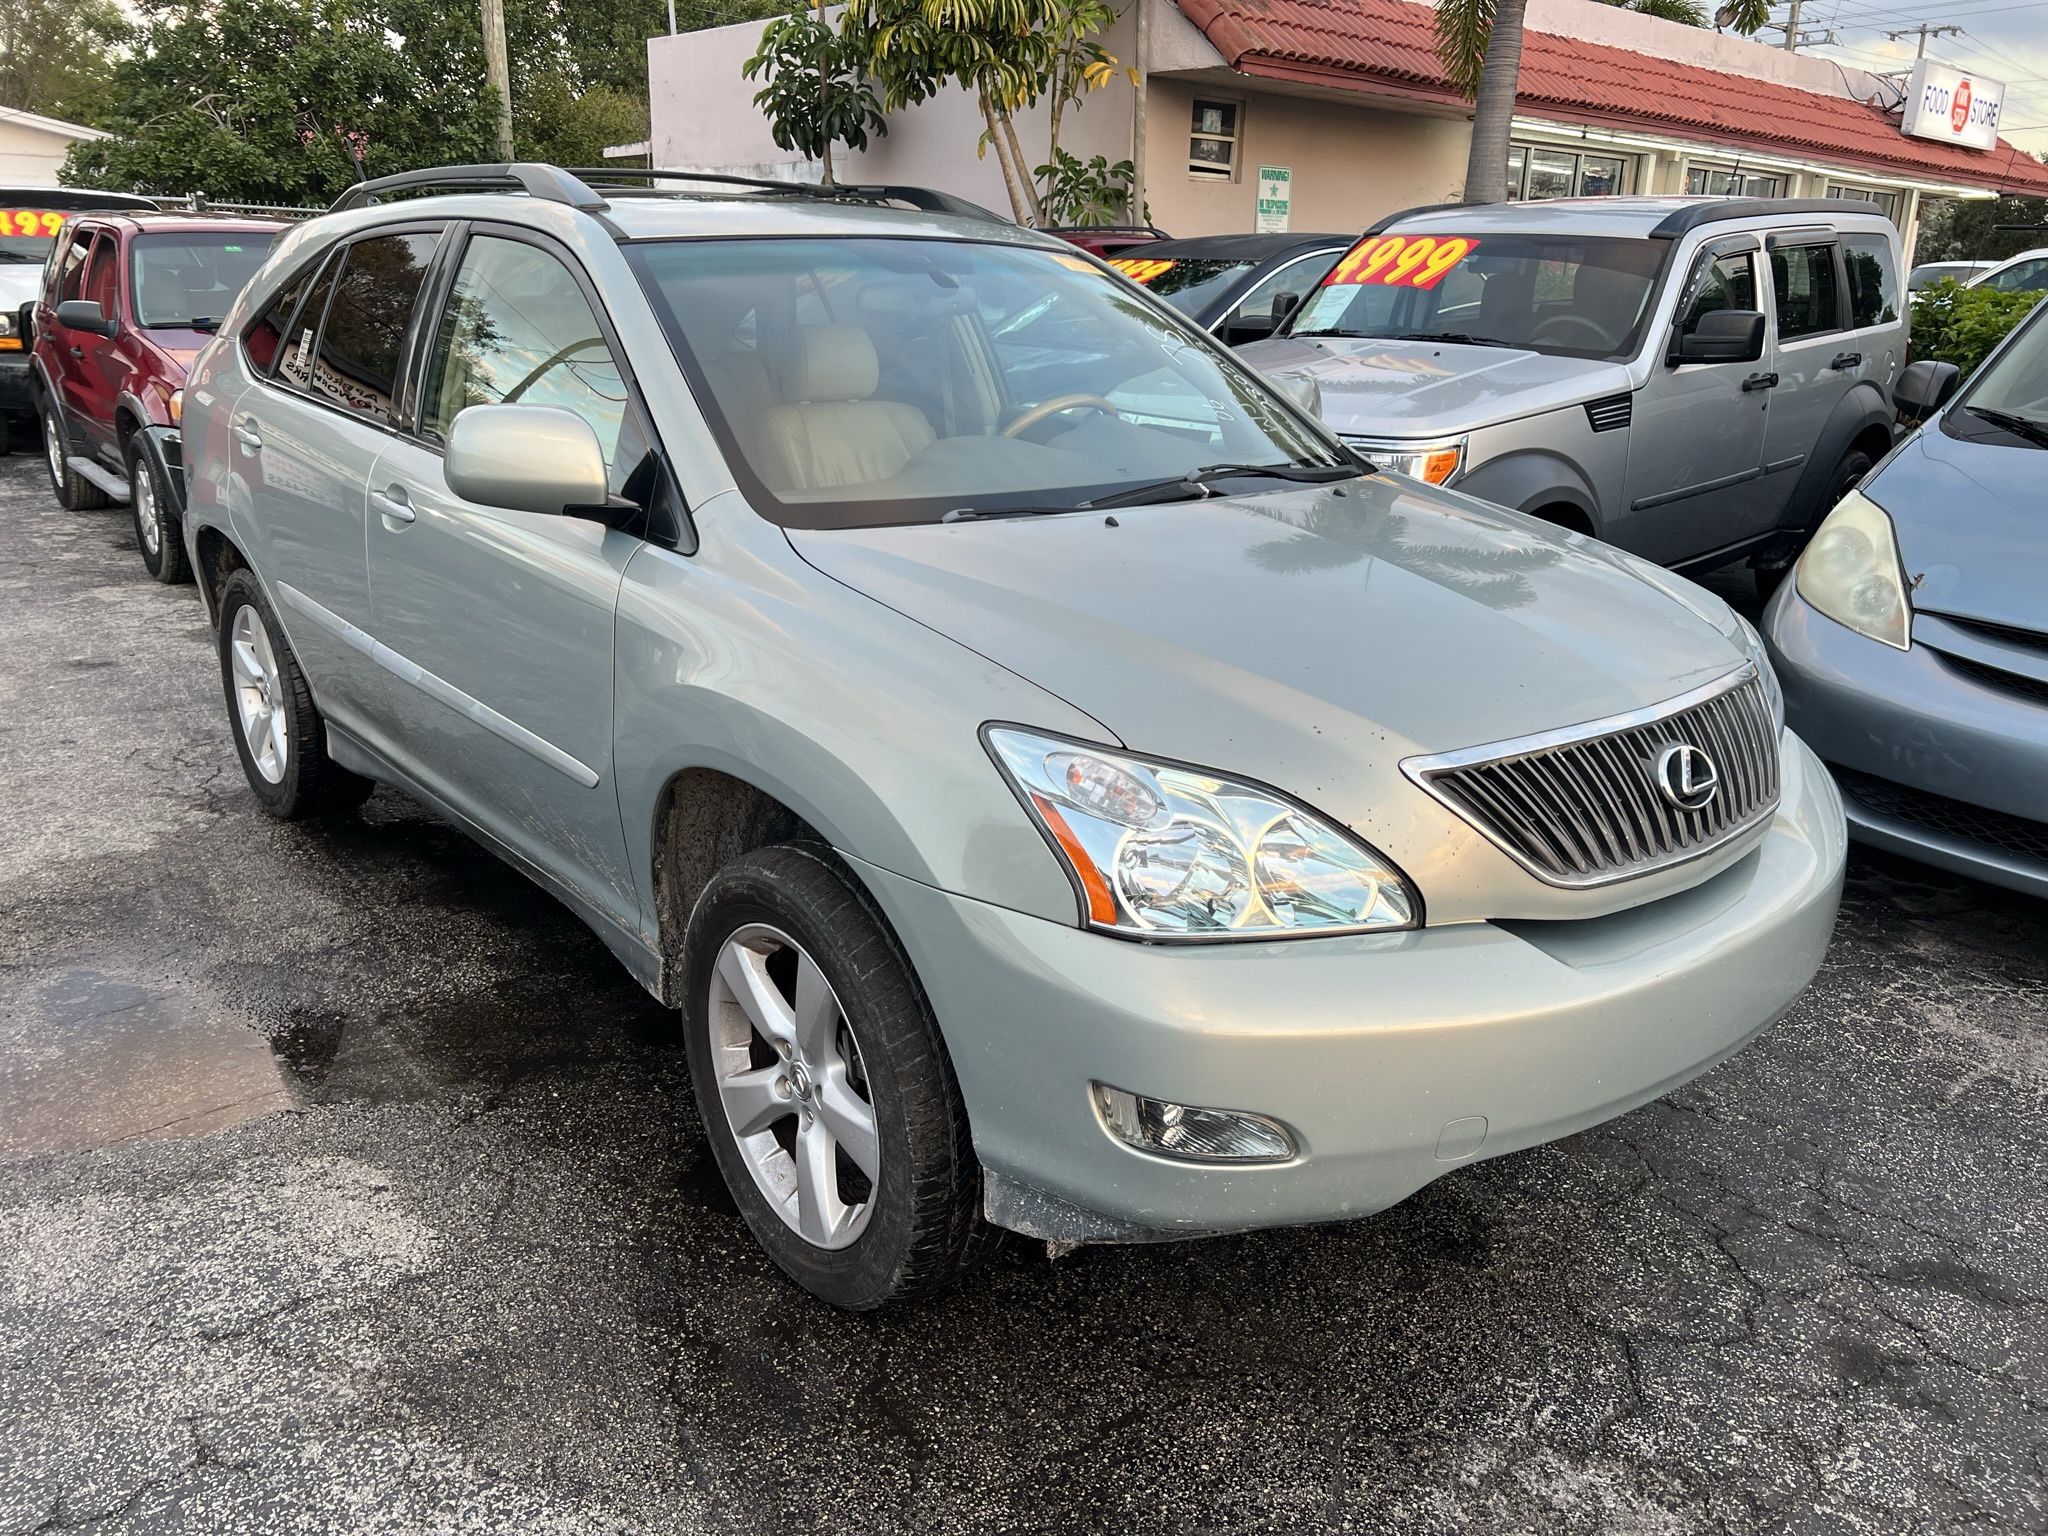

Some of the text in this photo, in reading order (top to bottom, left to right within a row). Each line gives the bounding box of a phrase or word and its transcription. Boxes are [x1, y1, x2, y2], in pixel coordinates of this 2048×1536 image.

[1923, 85, 1998, 127] FOOD STORE
[1261, 169, 1289, 182] WARNING!
[1334, 236, 1469, 286] 4999
